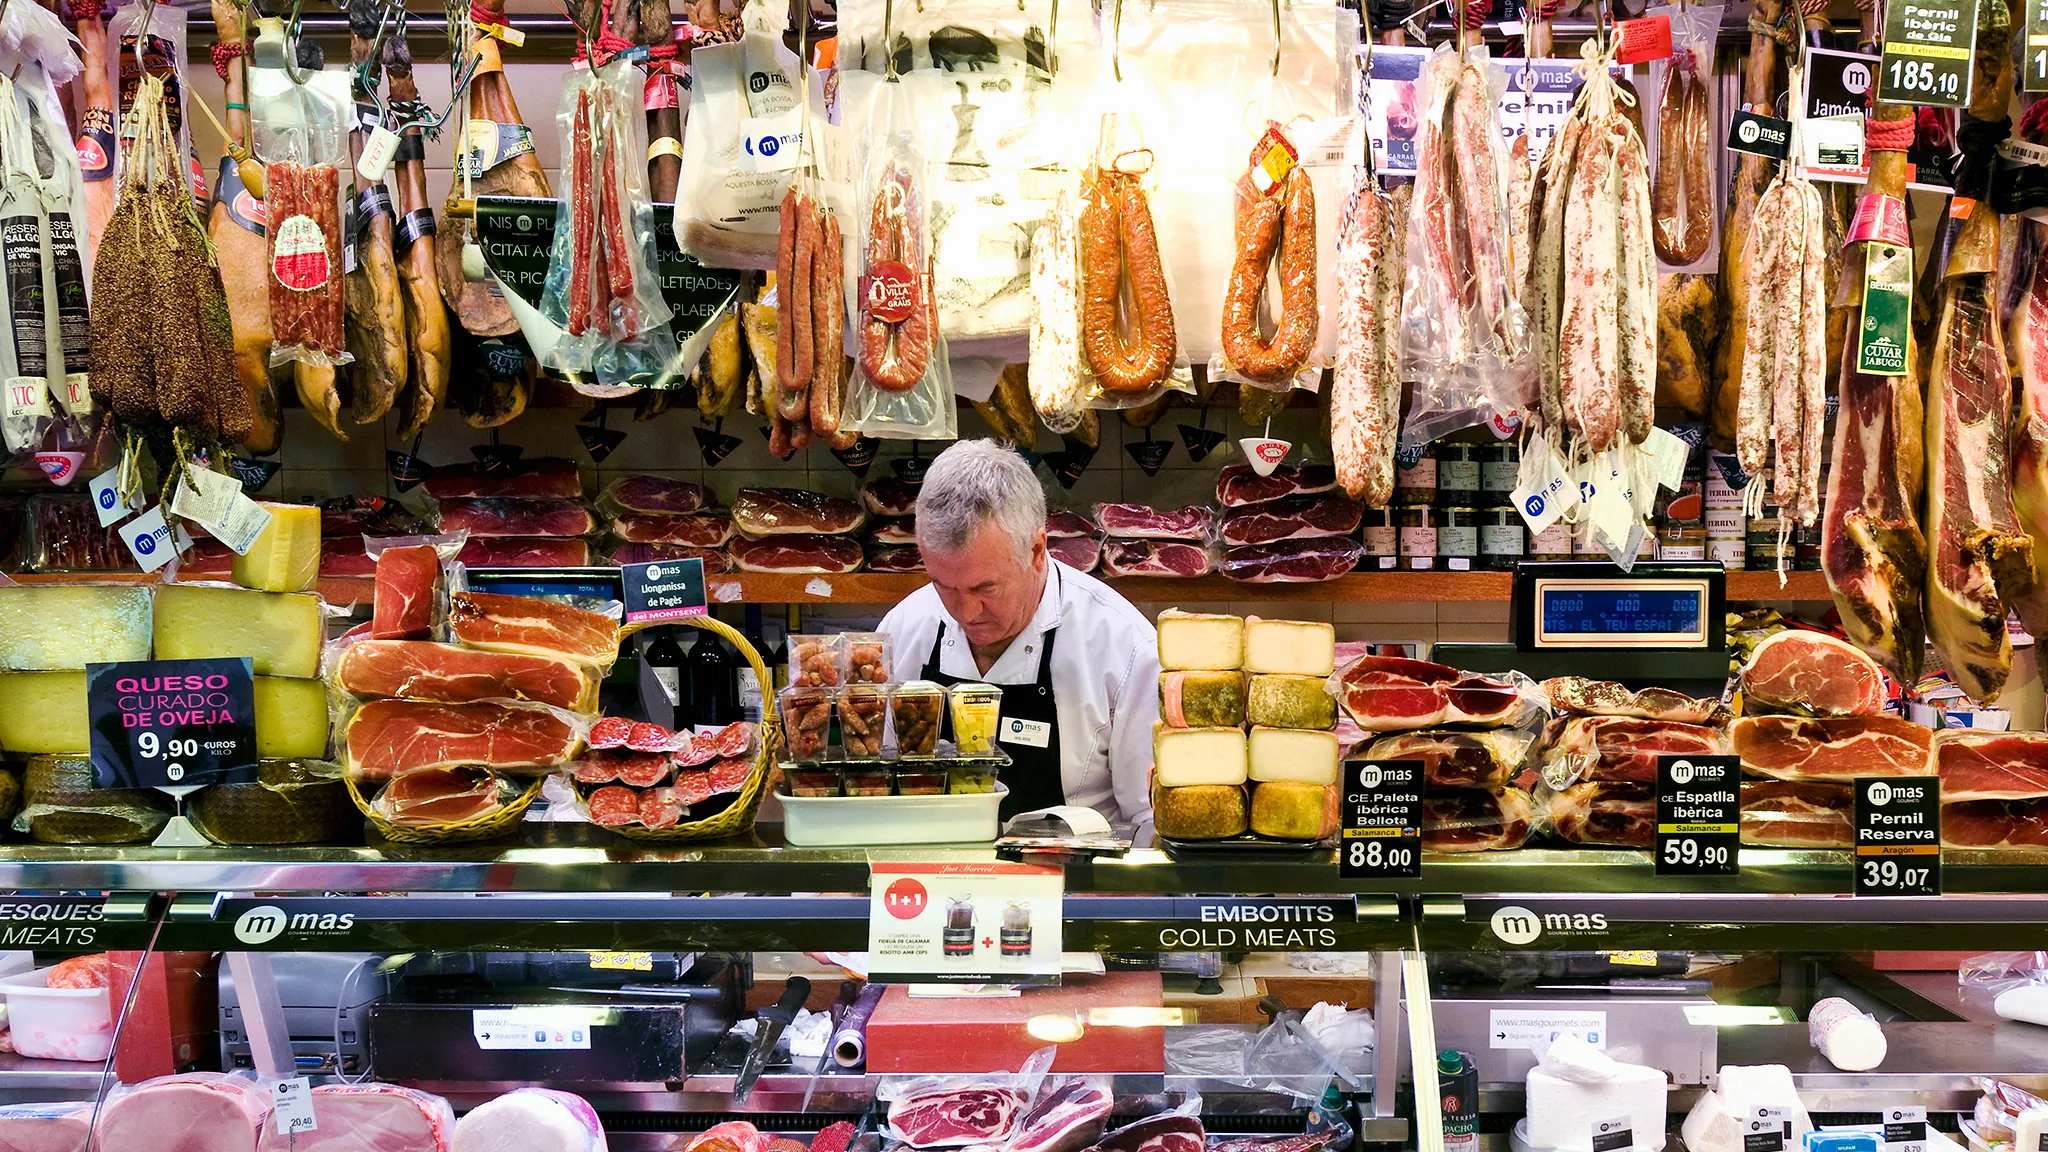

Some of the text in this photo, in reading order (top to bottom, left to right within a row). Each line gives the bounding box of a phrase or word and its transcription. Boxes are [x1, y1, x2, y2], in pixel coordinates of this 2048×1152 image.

[1904, 6, 1959, 19] Pernil
[1911, 46, 1966, 58] Extremadura
[1542, 71, 1572, 84] mas
[1890, 60, 1958, 95] 185,10
[1760, 127, 1786, 142] mas
[490, 216, 512, 229] NIS
[490, 243, 530, 256] CITAT
[886, 288, 908, 296] VILLA
[888, 299, 912, 308] GRAUS
[1864, 345, 1902, 358] CUYAR
[1864, 356, 1902, 368] JABUGO
[12, 386, 36, 406] VIC
[662, 566, 680, 574] mas
[641, 582, 686, 594] Llonganissa
[648, 595, 682, 606] de Pagès
[650, 608, 702, 618] MONTSENY
[1582, 620, 1596, 631] EL
[1605, 620, 1628, 631] TEU
[1635, 620, 1672, 631] ESPAI
[116, 674, 228, 693] QUESO
[118, 692, 229, 711] CURADO
[122, 710, 234, 728] DE OVEJA
[1025, 724, 1042, 732] mas
[138, 732, 198, 760] 9,90
[1384, 770, 1412, 780] mas
[1695, 766, 1726, 776] mas
[1676, 791, 1734, 804] Espatlla
[1893, 787, 1924, 798] mas
[1357, 804, 1408, 814] ibérica
[1674, 806, 1723, 818] ibèrica
[1357, 816, 1408, 826] Bellota
[1870, 812, 1923, 824] Pernil
[1860, 829, 1934, 840] Reserva
[1350, 842, 1412, 870] 88,00
[1664, 839, 1728, 867] 59,90
[1864, 861, 1930, 889] 39,07
[890, 894, 922, 906] 1+1
[1200, 906, 1334, 923] EMBOTITS
[290, 914, 355, 930] mas
[1544, 914, 1608, 930] mas
[2, 927, 96, 946] MEATS
[1160, 928, 1336, 947] COLD MEATS
[1496, 1018, 1600, 1028] www.masgourmets.com
[291, 1117, 312, 1127] 20,40
